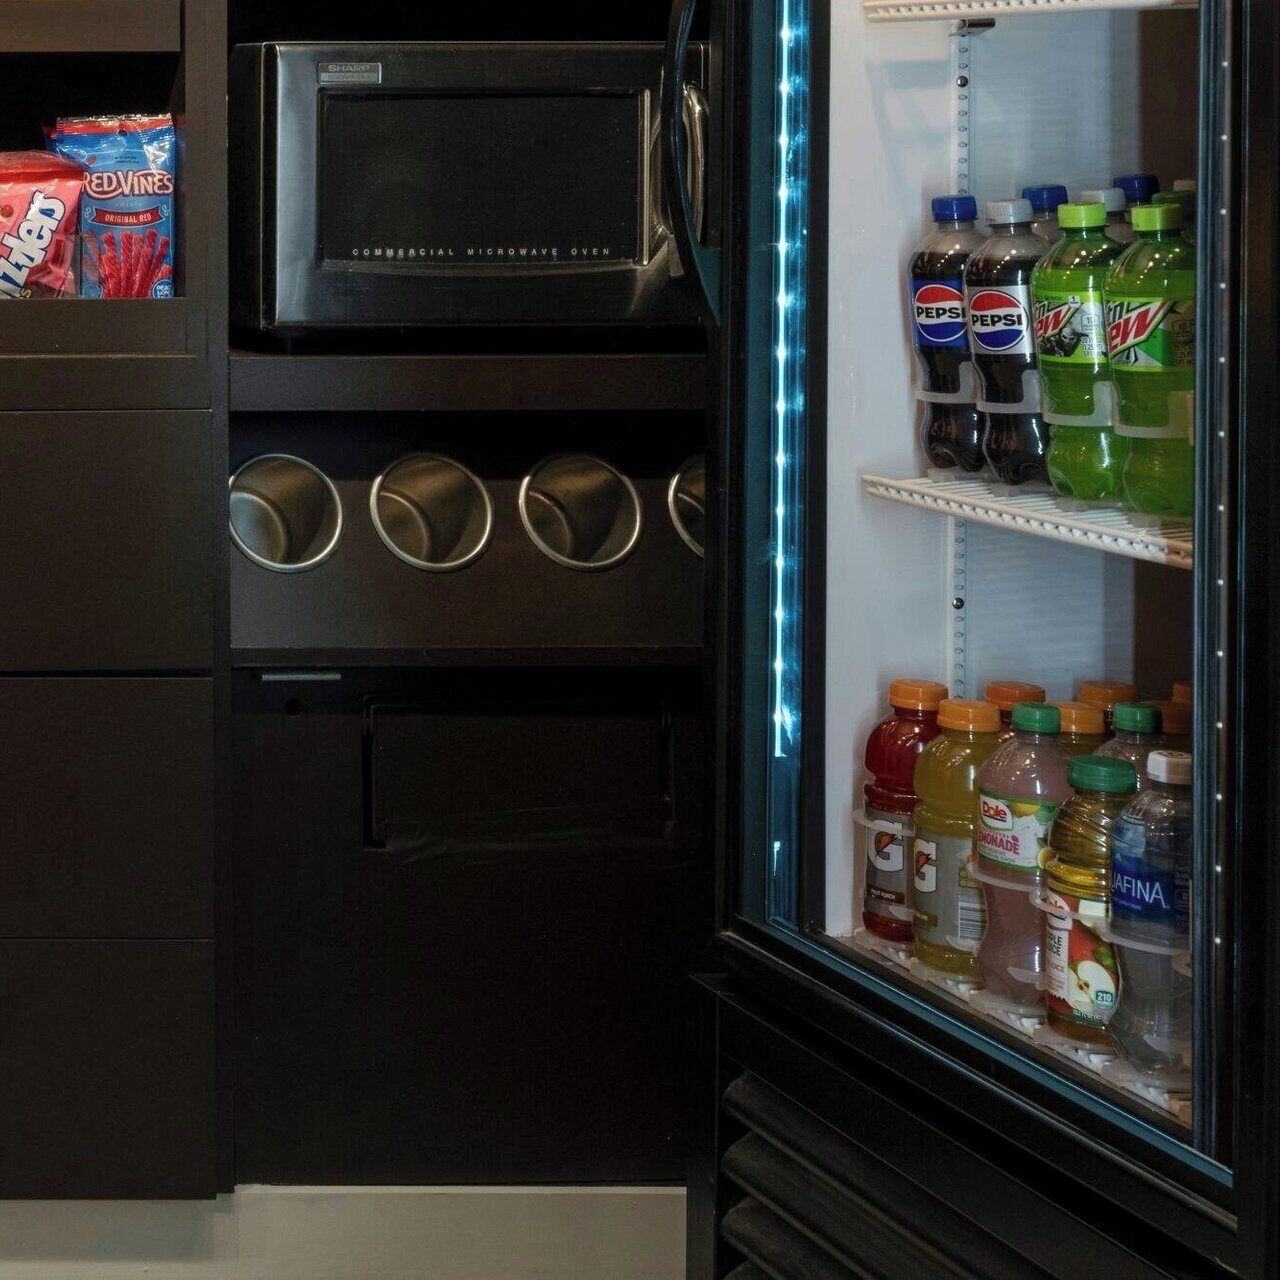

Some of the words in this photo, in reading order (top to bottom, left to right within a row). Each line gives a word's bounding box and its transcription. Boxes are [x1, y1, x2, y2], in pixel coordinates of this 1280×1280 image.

[328, 64, 370, 72] SHARP
[105, 213, 138, 224] ORIGINAL
[139, 212, 152, 222] RED
[352, 247, 455, 257] COMMERCIAL
[467, 247, 558, 257] MICROWAVE
[571, 246, 611, 256] OVEN
[916, 306, 967, 322] PEPSI
[971, 313, 1024, 328] PEPSI
[982, 800, 1008, 819] Dole
[868, 819, 904, 872] G
[914, 838, 937, 893] G
[1097, 992, 1113, 1002] 210
